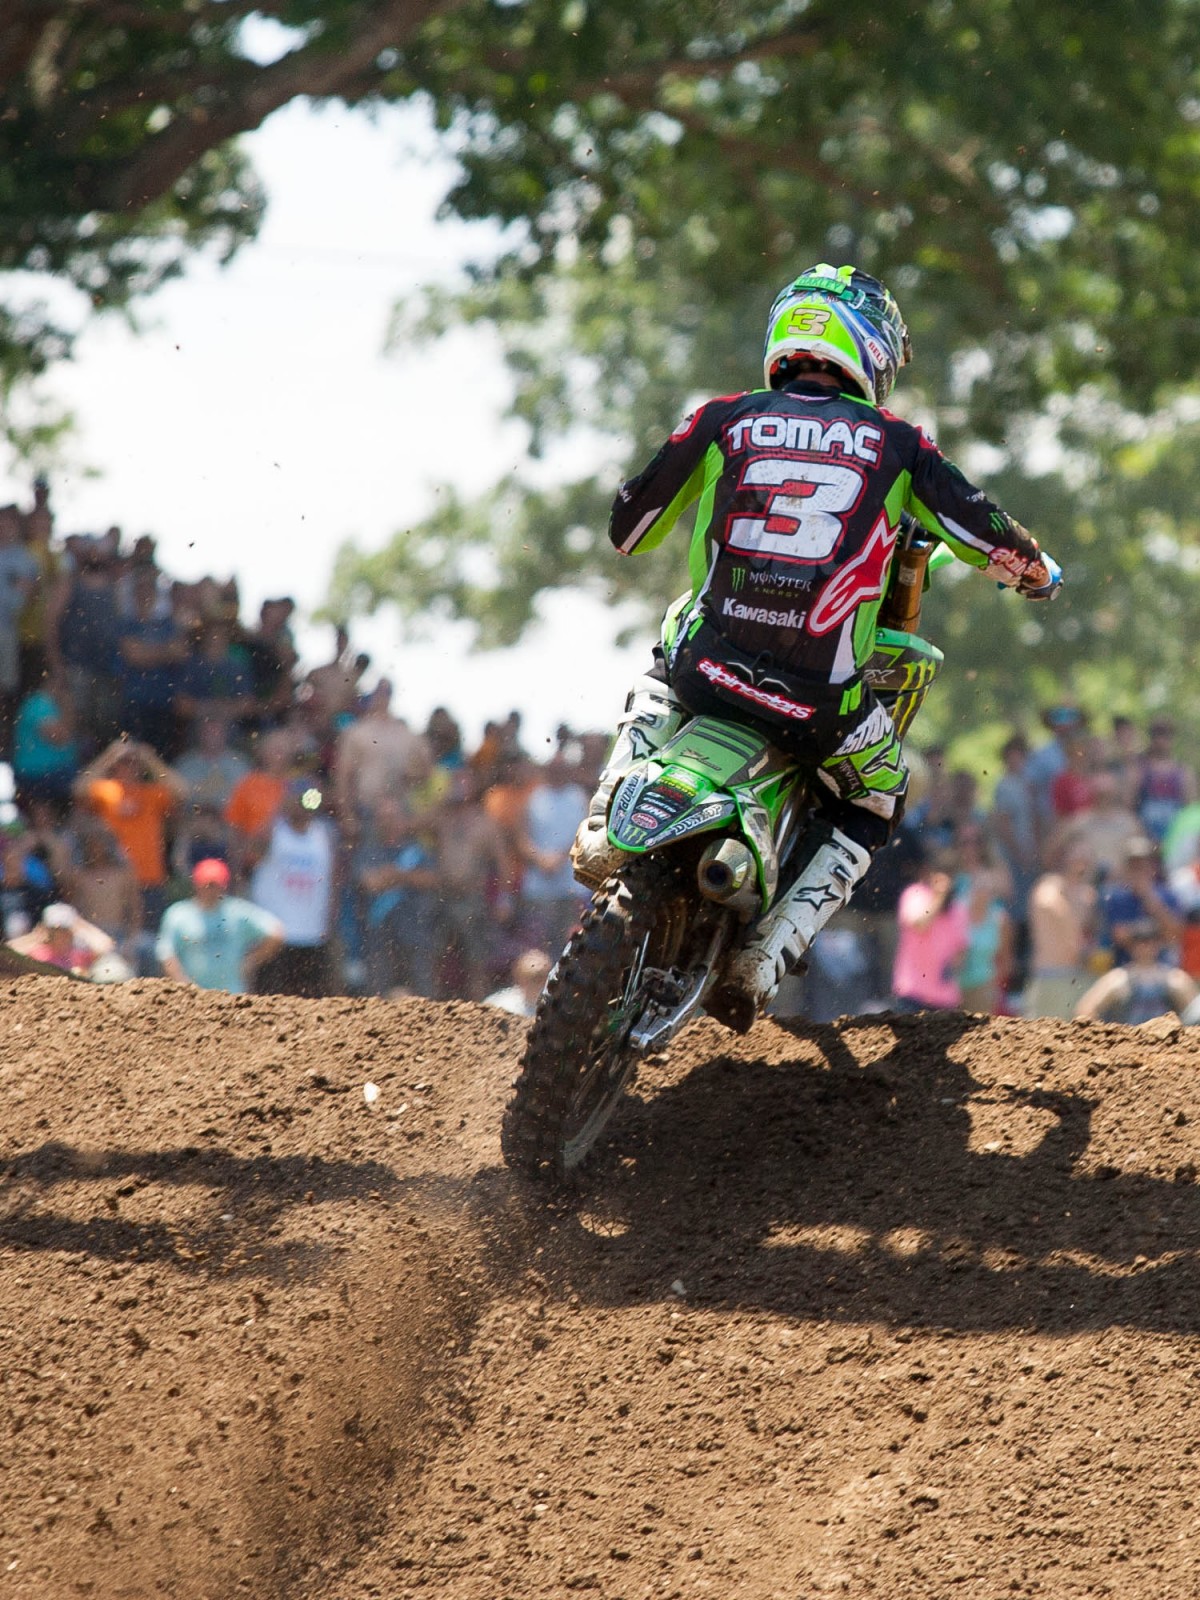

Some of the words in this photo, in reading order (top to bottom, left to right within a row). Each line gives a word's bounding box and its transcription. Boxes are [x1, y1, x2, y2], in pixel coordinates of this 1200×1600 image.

[787, 307, 832, 336] 3
[867, 341, 886, 365] BELL
[726, 415, 882, 465] TOMAC
[727, 457, 866, 561] 3
[750, 572, 813, 592] MONSTER
[753, 587, 799, 598] ENERGY
[722, 597, 806, 629] Kawasaki
[699, 660, 811, 719] alpinestars
[674, 803, 723, 836] DUNLOP
